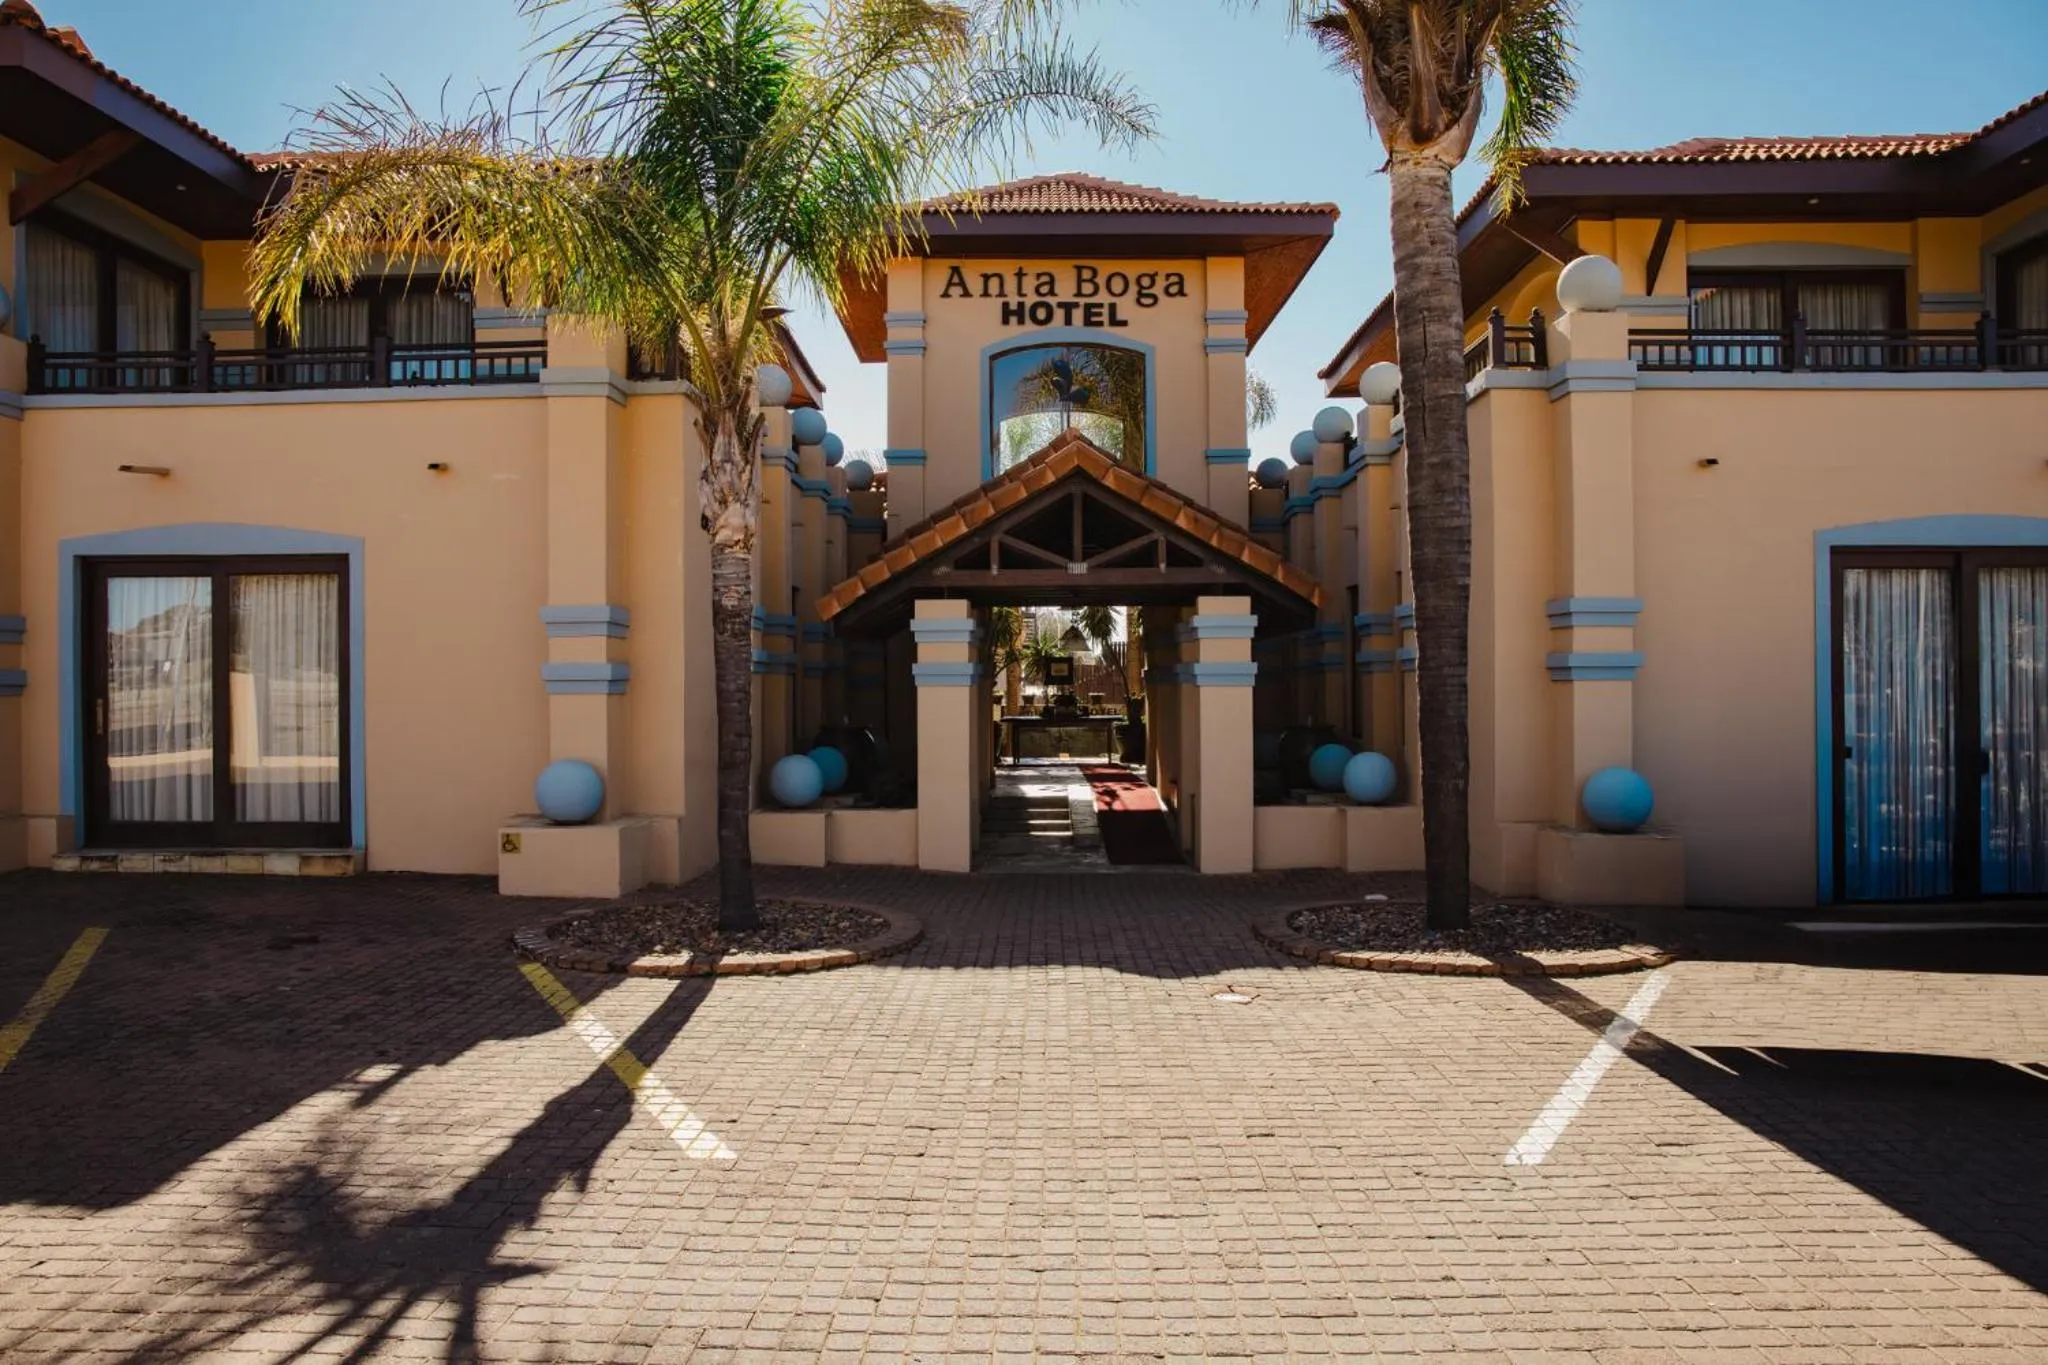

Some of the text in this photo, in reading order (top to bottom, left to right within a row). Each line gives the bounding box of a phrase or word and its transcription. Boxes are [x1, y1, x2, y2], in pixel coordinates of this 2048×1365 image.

[940, 264, 1187, 307] Anta Boga
[1001, 301, 1129, 327] HOTEL
